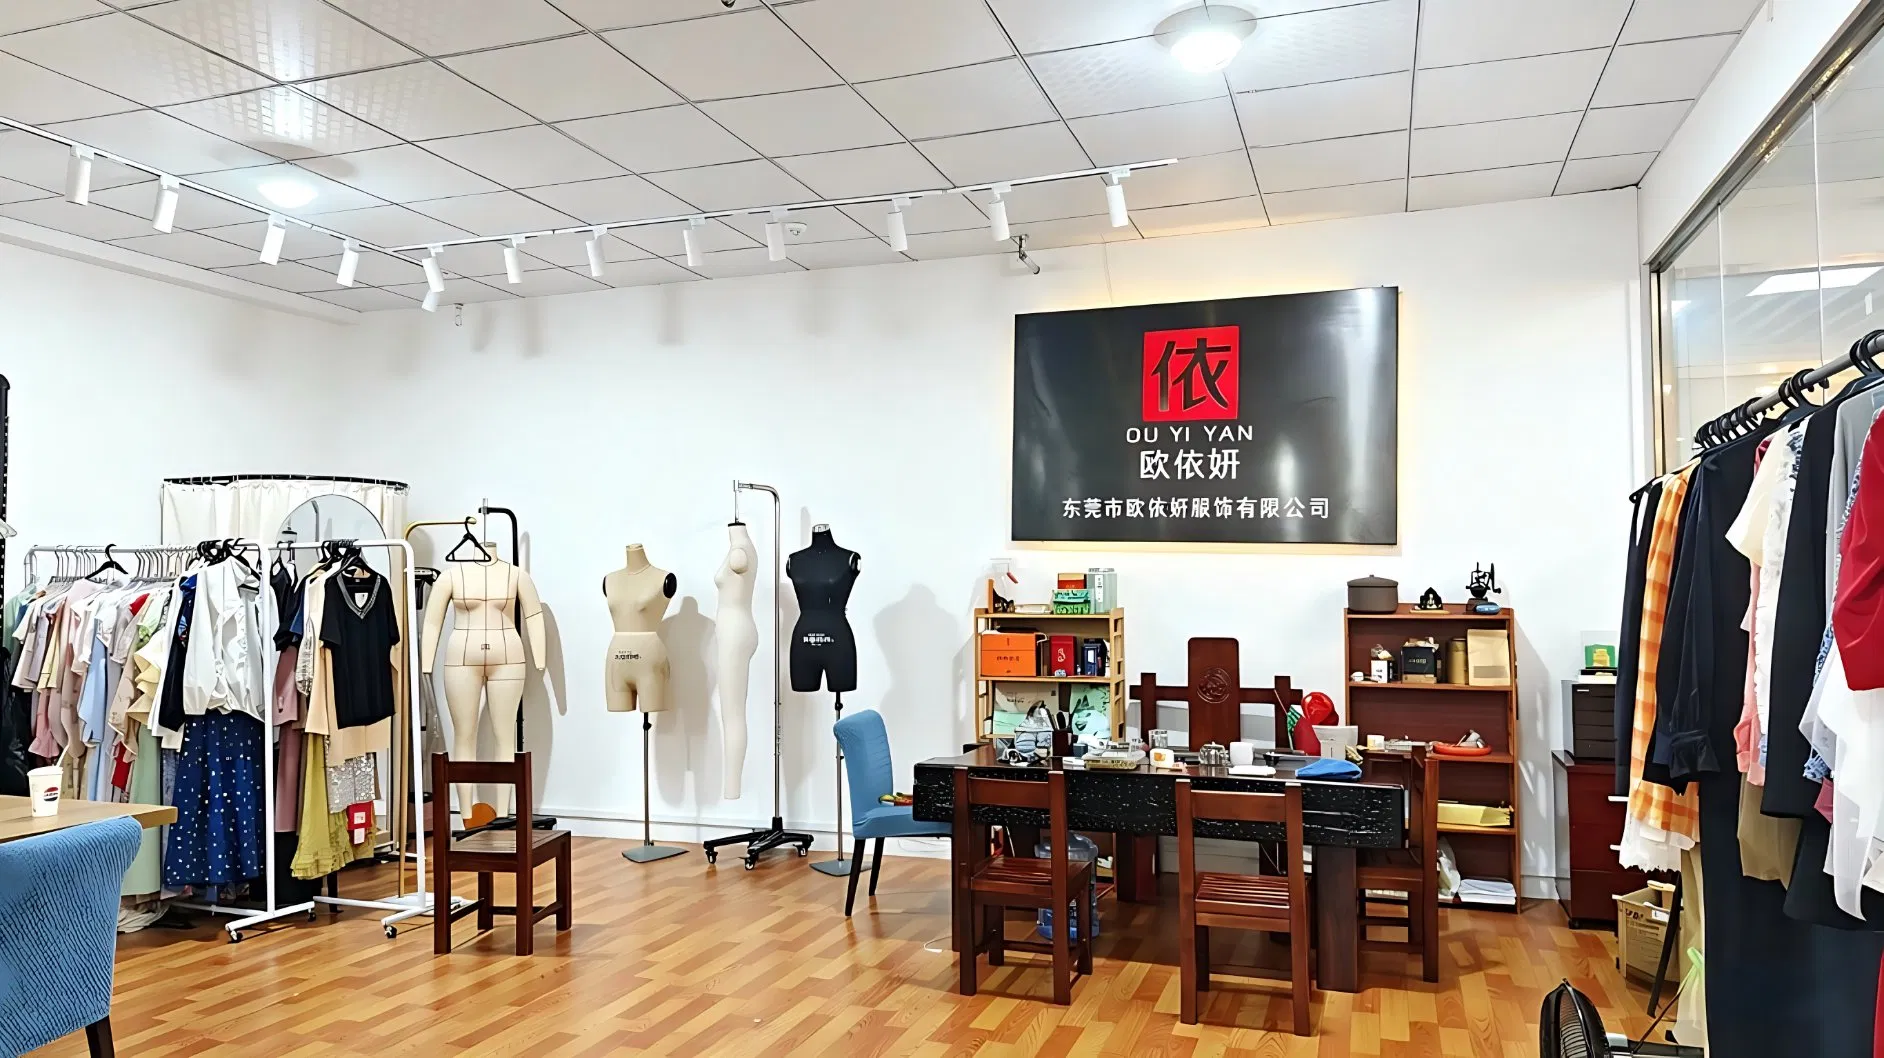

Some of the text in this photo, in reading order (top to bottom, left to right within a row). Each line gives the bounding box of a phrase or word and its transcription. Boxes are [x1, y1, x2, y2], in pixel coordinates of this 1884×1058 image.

[1151, 338, 1232, 412] 依
[1126, 425, 1254, 444] OU YI YAN
[1140, 448, 1241, 480] 欧依妍
[1062, 497, 1330, 519] 东莞市欧依妍服饰有限公司
